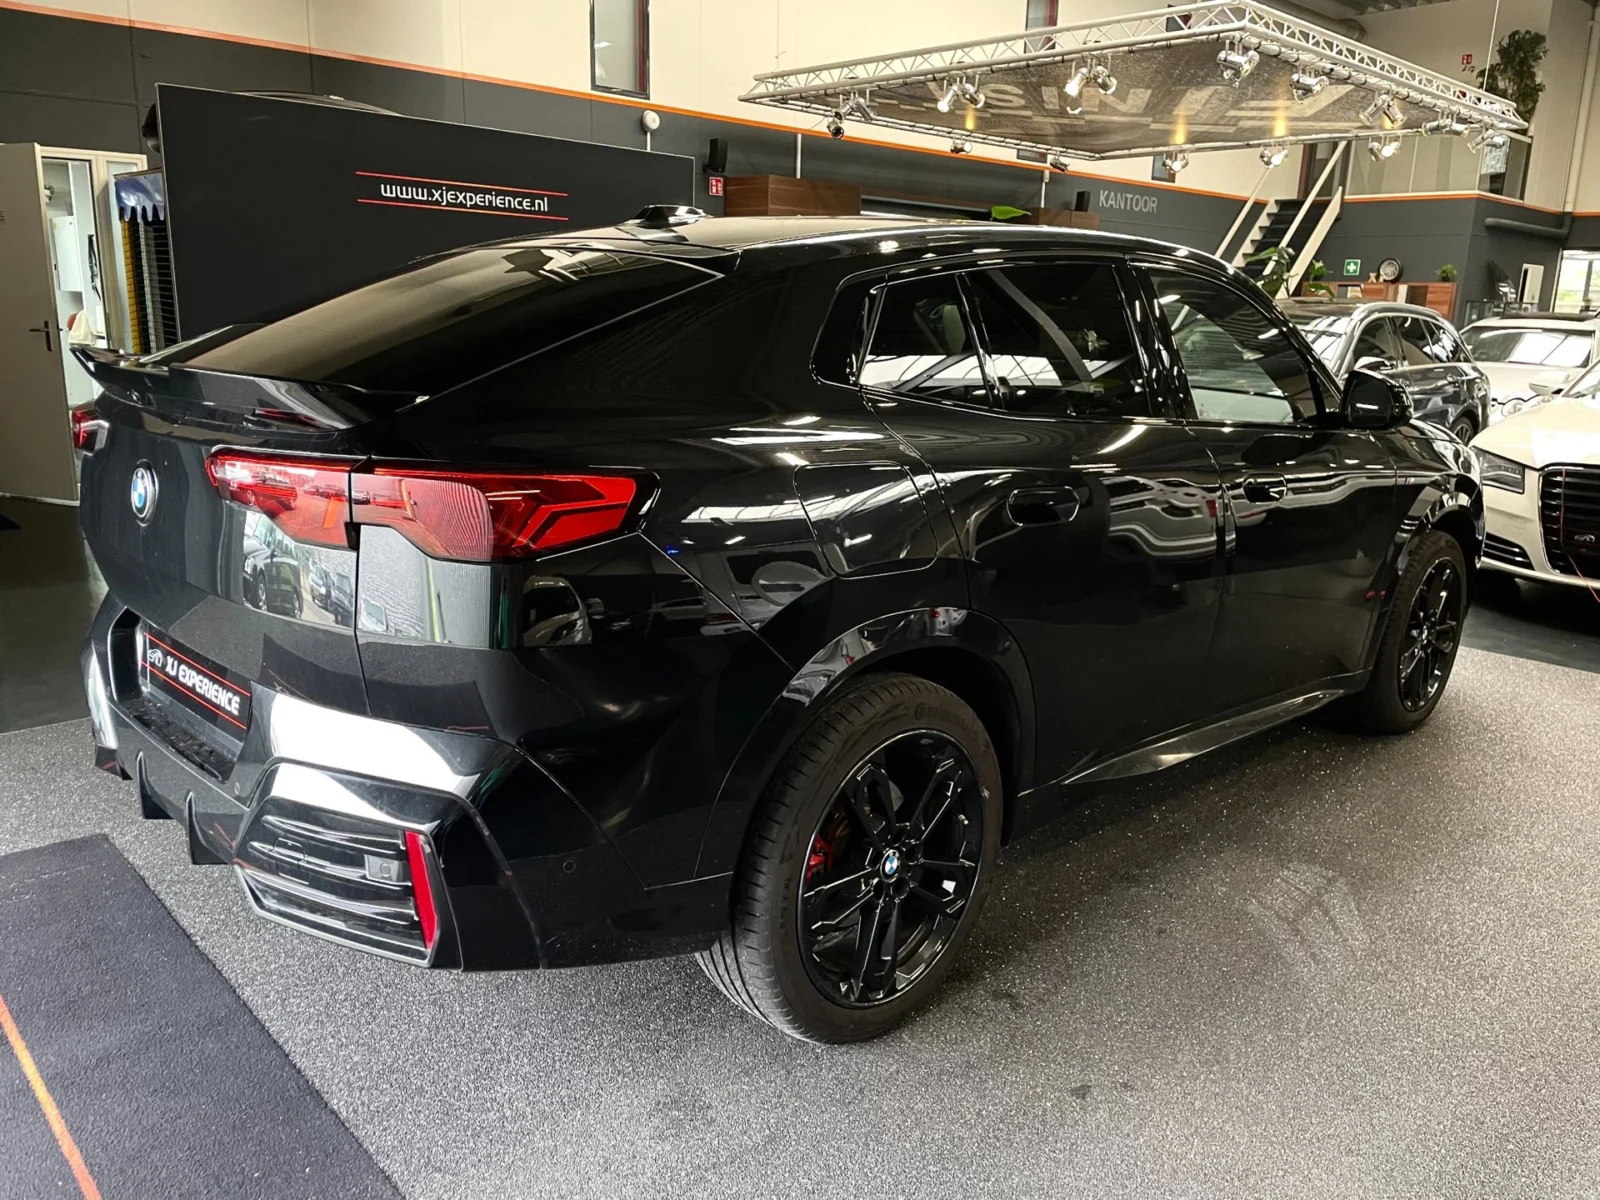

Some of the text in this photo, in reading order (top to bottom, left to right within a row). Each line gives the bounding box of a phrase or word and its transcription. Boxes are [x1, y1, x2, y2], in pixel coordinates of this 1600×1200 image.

[380, 184, 548, 212] www.xjexperience.nl
[1099, 189, 1158, 213] KANTOOR
[165, 655, 240, 716] XJ EXPERIENCE
